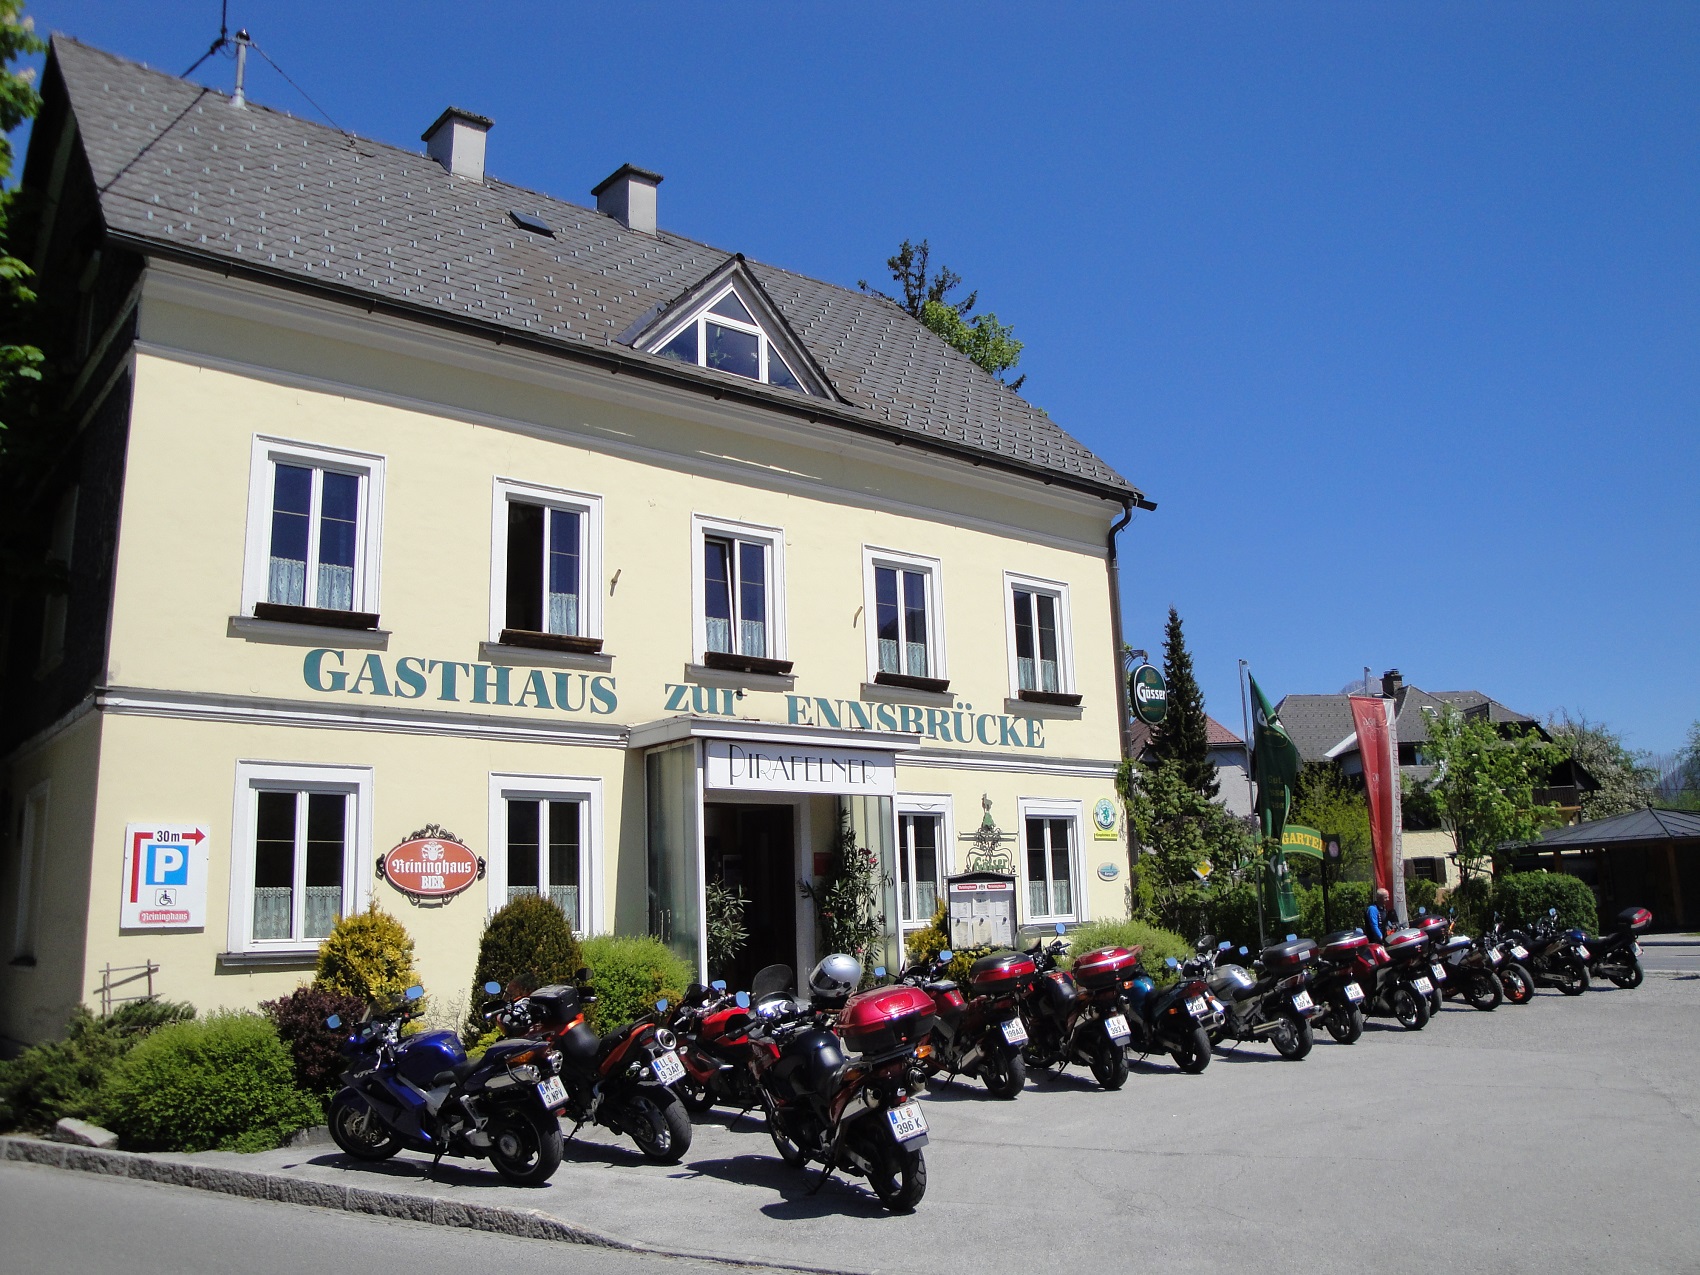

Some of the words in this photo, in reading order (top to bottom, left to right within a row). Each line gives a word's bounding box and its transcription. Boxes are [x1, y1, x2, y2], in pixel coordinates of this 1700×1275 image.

[303, 648, 618, 715] GASTHAUS
[664, 684, 742, 716] zur
[785, 694, 1044, 749] ENNSBRÜCKE
[1136, 682, 1165, 703] Gösser
[729, 744, 877, 785] PIRAFELNER
[153, 847, 184, 883] P
[391, 859, 472, 875] Reininghaus
[421, 875, 446, 889] BIER
[896, 1120, 914, 1135] 396
[914, 1117, 922, 1129] K
